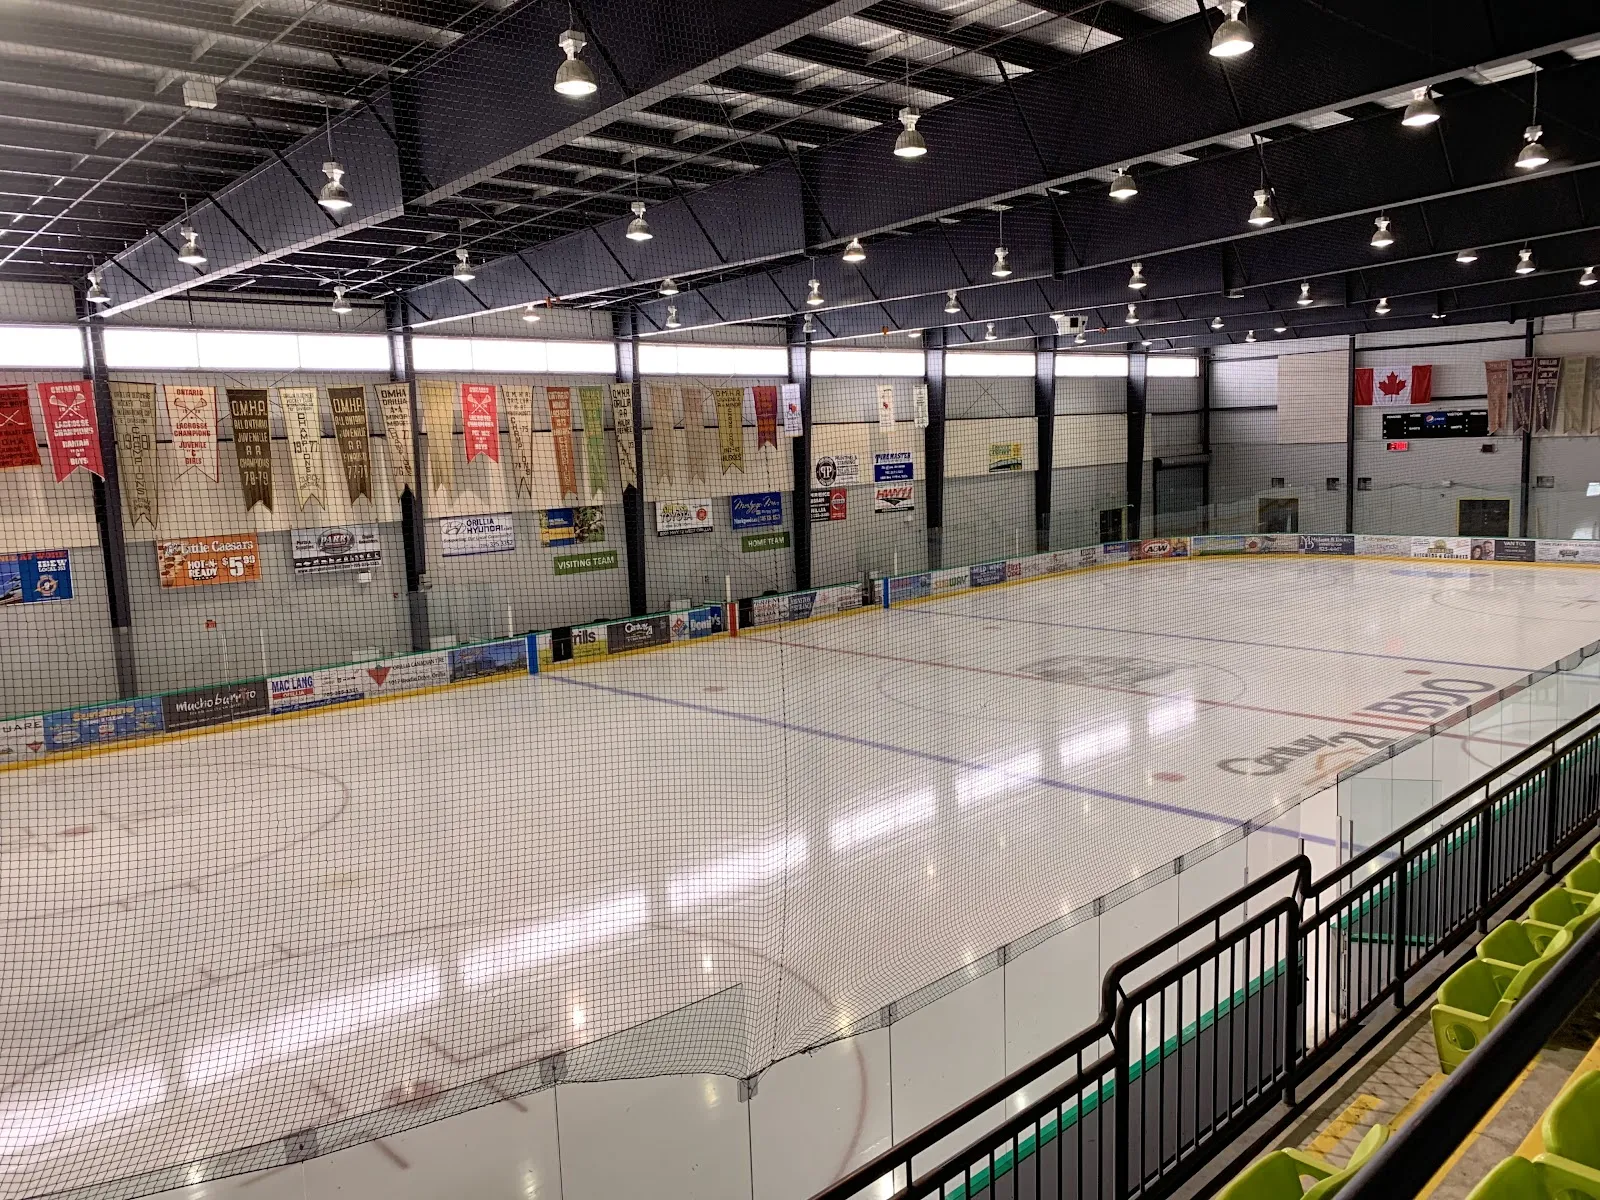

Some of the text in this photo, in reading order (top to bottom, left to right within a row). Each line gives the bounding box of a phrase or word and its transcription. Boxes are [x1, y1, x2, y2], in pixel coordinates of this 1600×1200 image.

[50, 385, 81, 394] ONTARIO
[176, 388, 204, 396] ONTARIO
[381, 389, 407, 398] OMHA
[54, 419, 89, 429] LACROSSE
[53, 427, 94, 437] CHAMPIONS
[237, 432, 268, 442] JUVENILE
[62, 439, 89, 448] BANTAM
[179, 441, 207, 449] JUVENILE
[466, 518, 494, 527] ORILLIA
[180, 540, 254, 554] Little Caesars
[748, 537, 785, 548] HOME TEAM
[1145, 545, 1169, 553] A&W
[37, 559, 68, 568] IBEW
[557, 556, 615, 570] VISITING TEAM
[188, 568, 218, 577] READY
[571, 630, 596, 646] rills
[271, 675, 313, 693] MAC LANG
[1364, 678, 1496, 719] BDO
